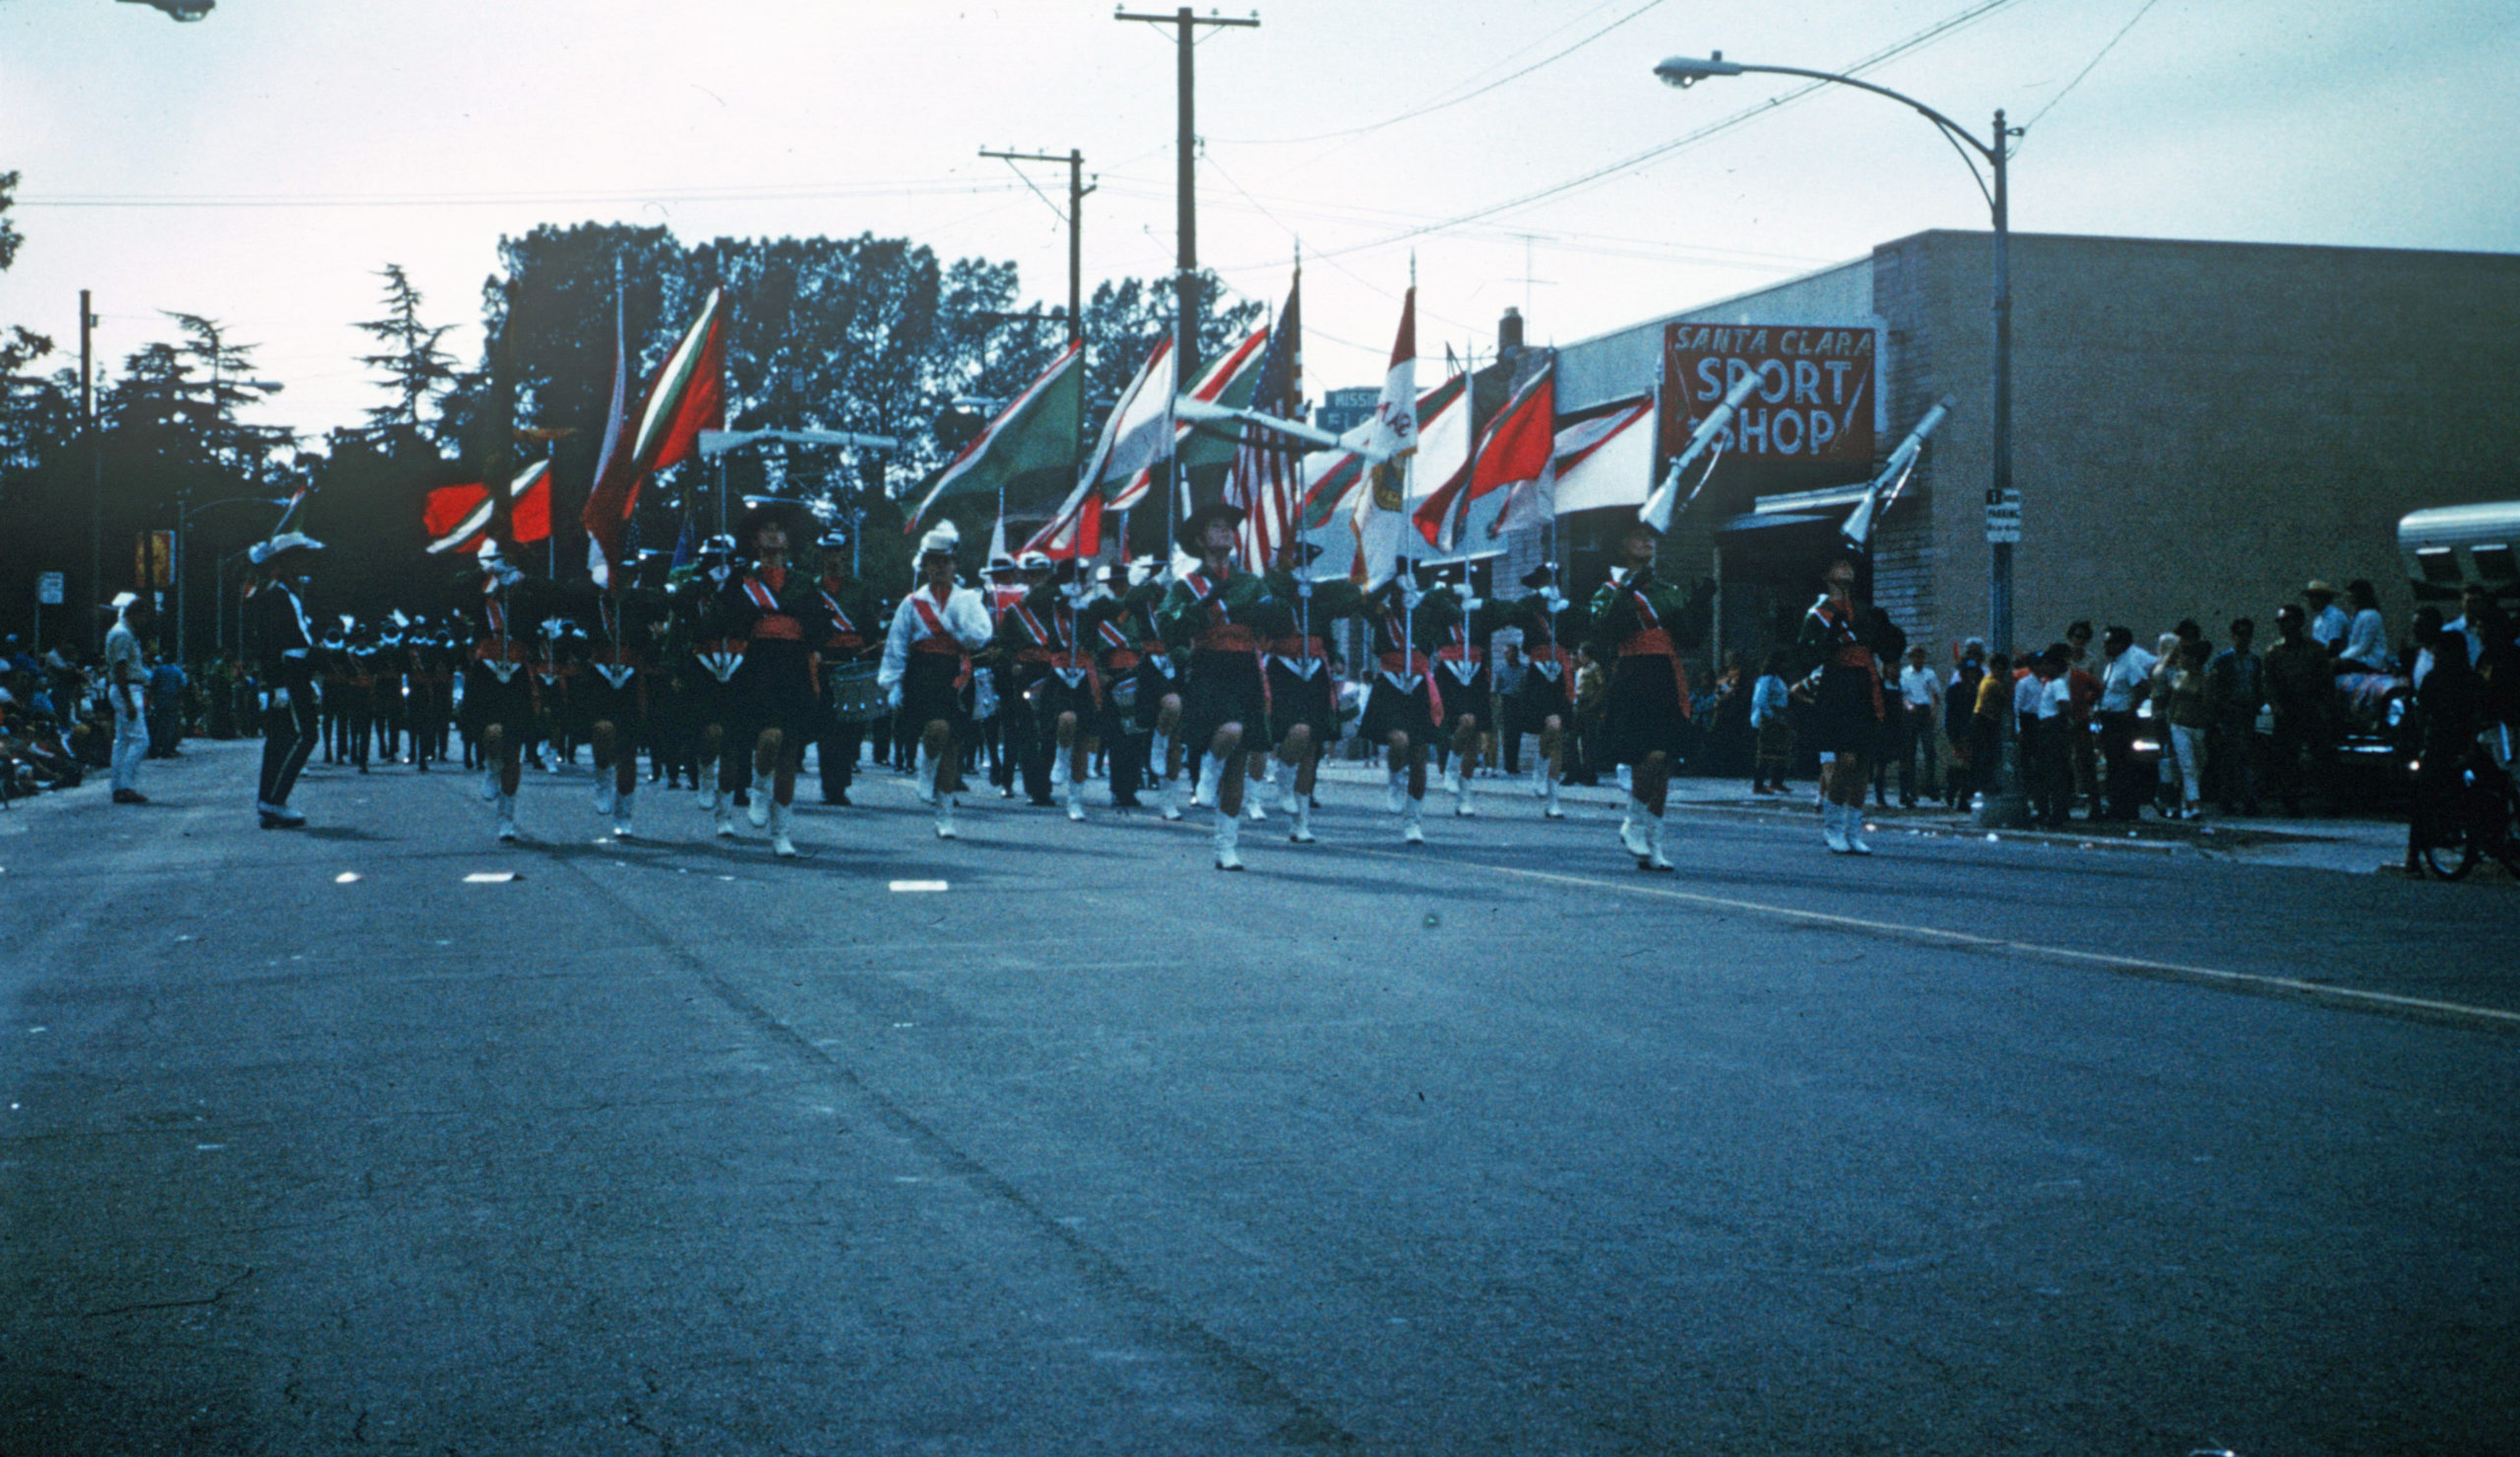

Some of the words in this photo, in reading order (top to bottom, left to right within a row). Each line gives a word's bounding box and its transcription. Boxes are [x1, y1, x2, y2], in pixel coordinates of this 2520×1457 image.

[1674, 327, 1768, 353] SANTA
[1780, 330, 1874, 356] CLARA
[1697, 356, 1852, 405] SPORT
